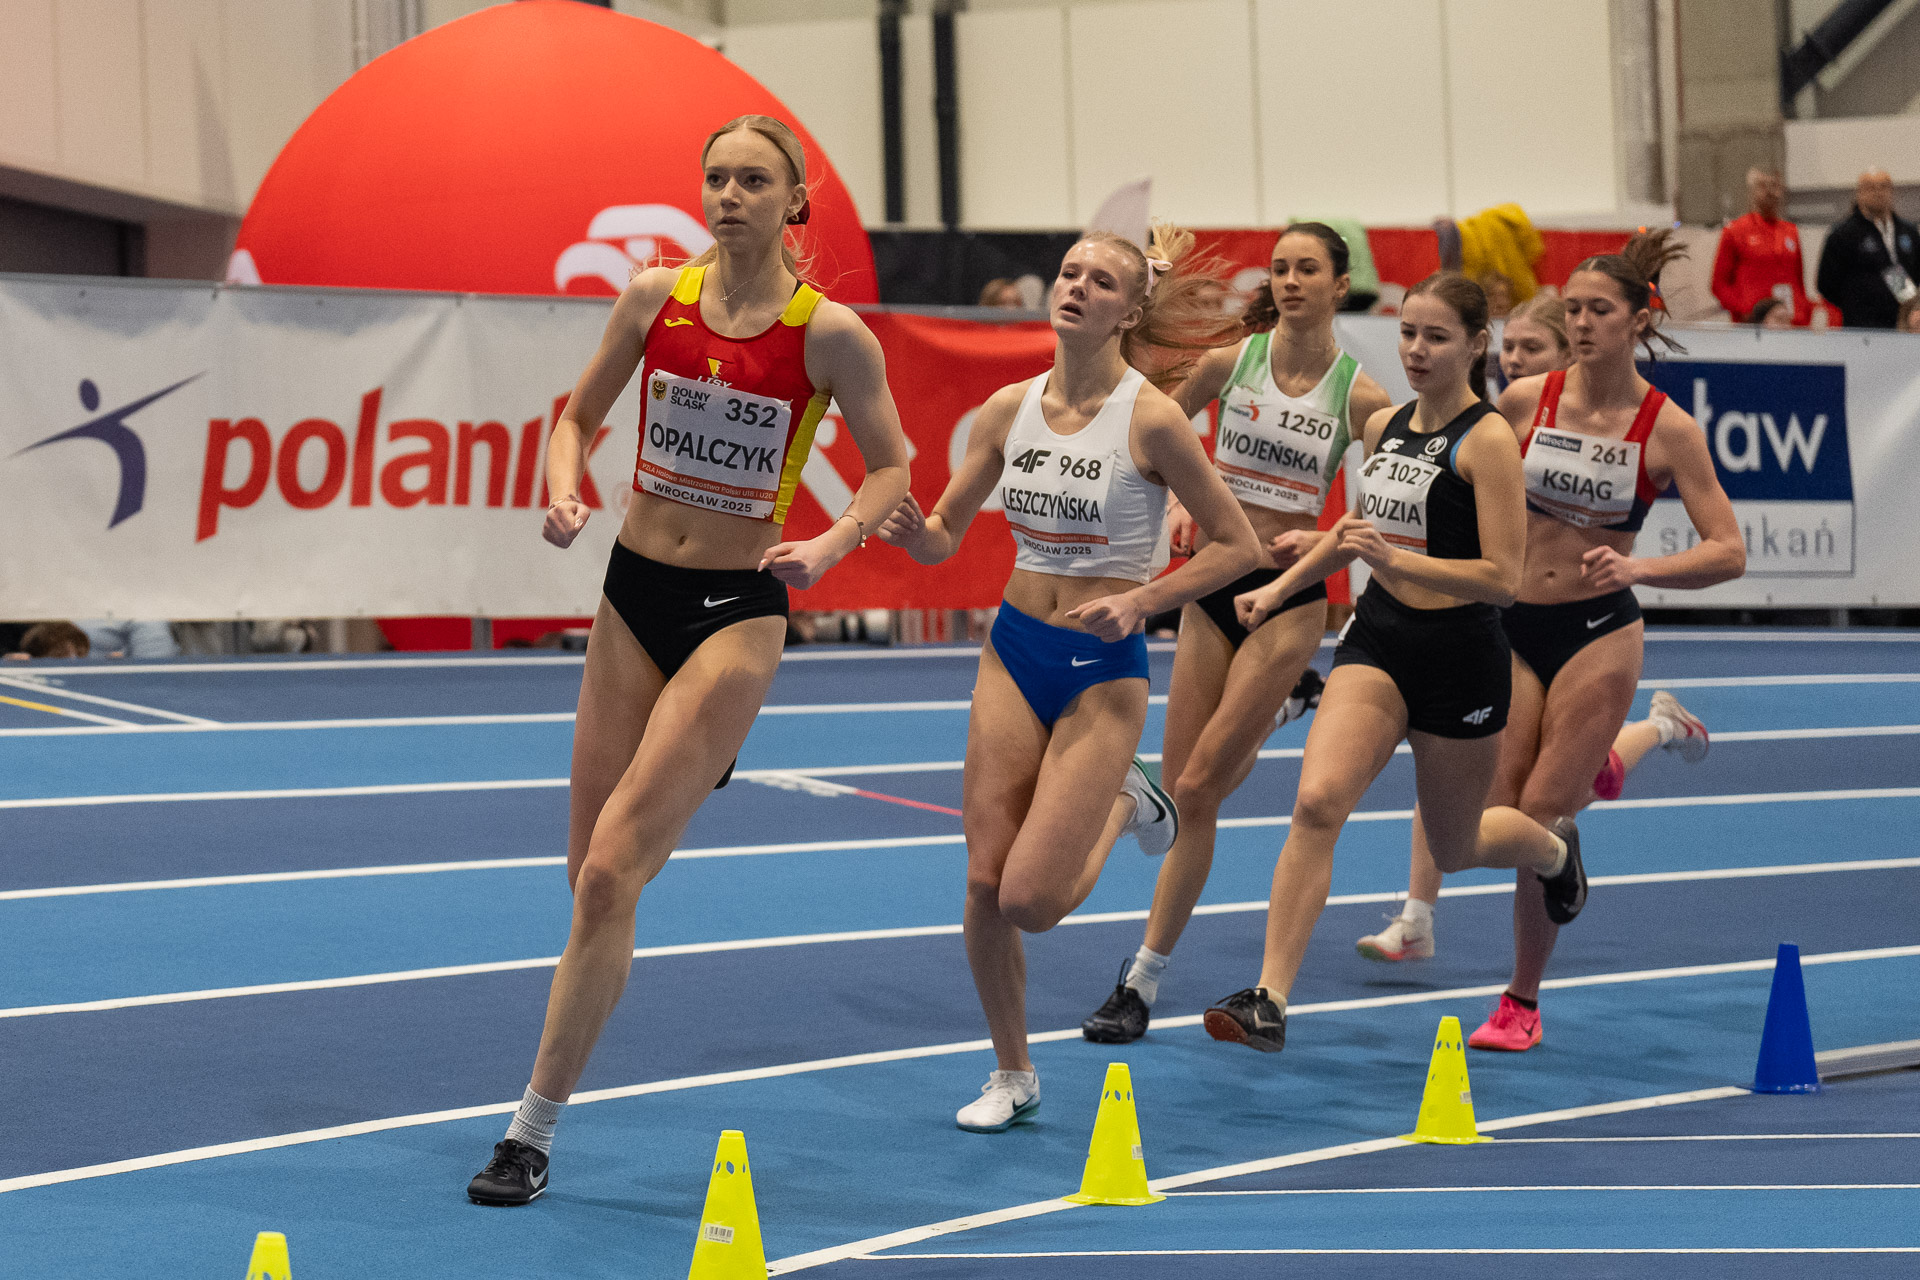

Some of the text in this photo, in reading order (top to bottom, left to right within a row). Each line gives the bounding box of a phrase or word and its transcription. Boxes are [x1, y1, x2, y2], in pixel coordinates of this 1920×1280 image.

[670, 393, 708, 411] ŚLĄSK
[671, 386, 711, 401] DOLNY
[725, 398, 778, 428] 352
[1277, 410, 1333, 440] 1250
[650, 422, 778, 474] OPALCZYK
[1221, 426, 1319, 474] WOJEŃSKA
[1591, 445, 1628, 467] 261
[1011, 448, 1102, 481] 4F 968
[1387, 462, 1434, 486] 1027
[642, 463, 656, 474] PZLA
[679, 477, 721, 491] Mistrzostwa
[721, 486, 742, 496] Polski
[759, 492, 774, 500] U20
[1221, 475, 1273, 494] WROCŁAW
[1274, 488, 1299, 501] 2025
[1542, 469, 1613, 502] KSIĄG
[653, 481, 753, 513] WROCŁAW 2025
[1002, 487, 1102, 523] LESZCZYŃSKA
[1022, 537, 1092, 555] WROCŁAW 2025
[1659, 513, 1836, 557] stkań
[1462, 705, 1493, 725] 4F
